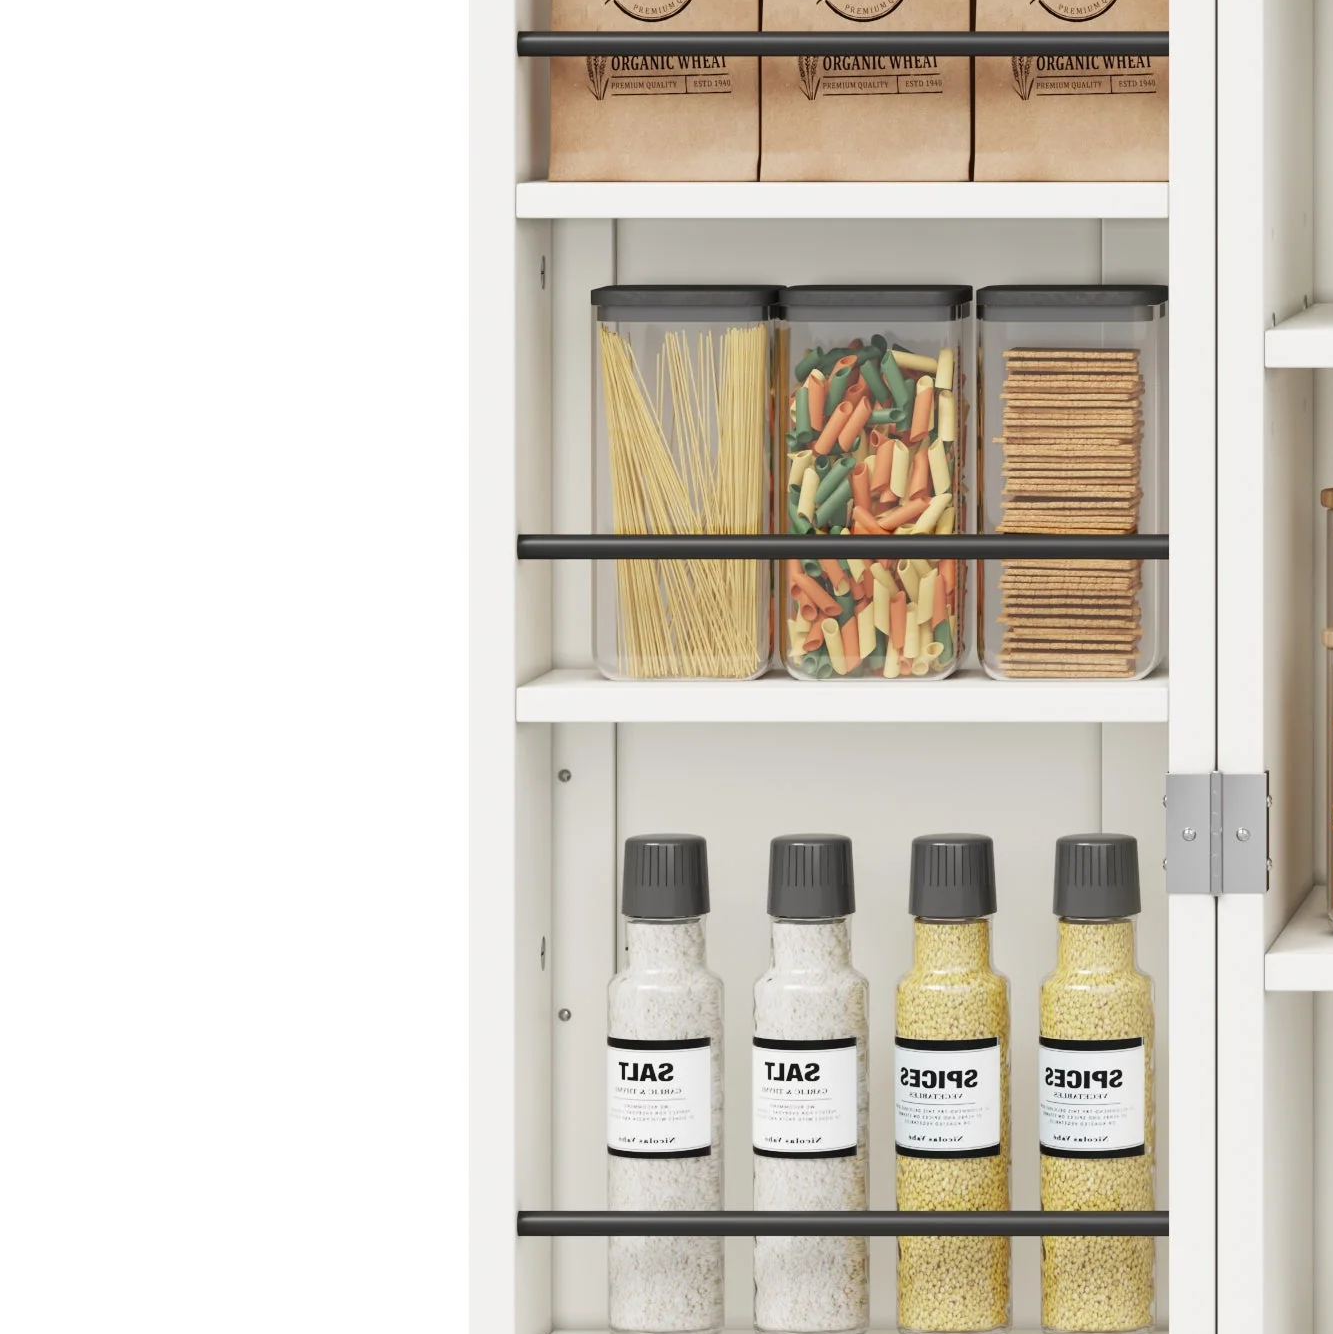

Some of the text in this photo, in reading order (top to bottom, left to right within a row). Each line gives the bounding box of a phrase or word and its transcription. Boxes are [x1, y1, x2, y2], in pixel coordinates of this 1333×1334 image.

[611, 55, 727, 71] ORGANIC WHEAT
[611, 80, 677, 90] PREMIUM QUALITY
[693, 79, 731, 88] ESTD 1940
